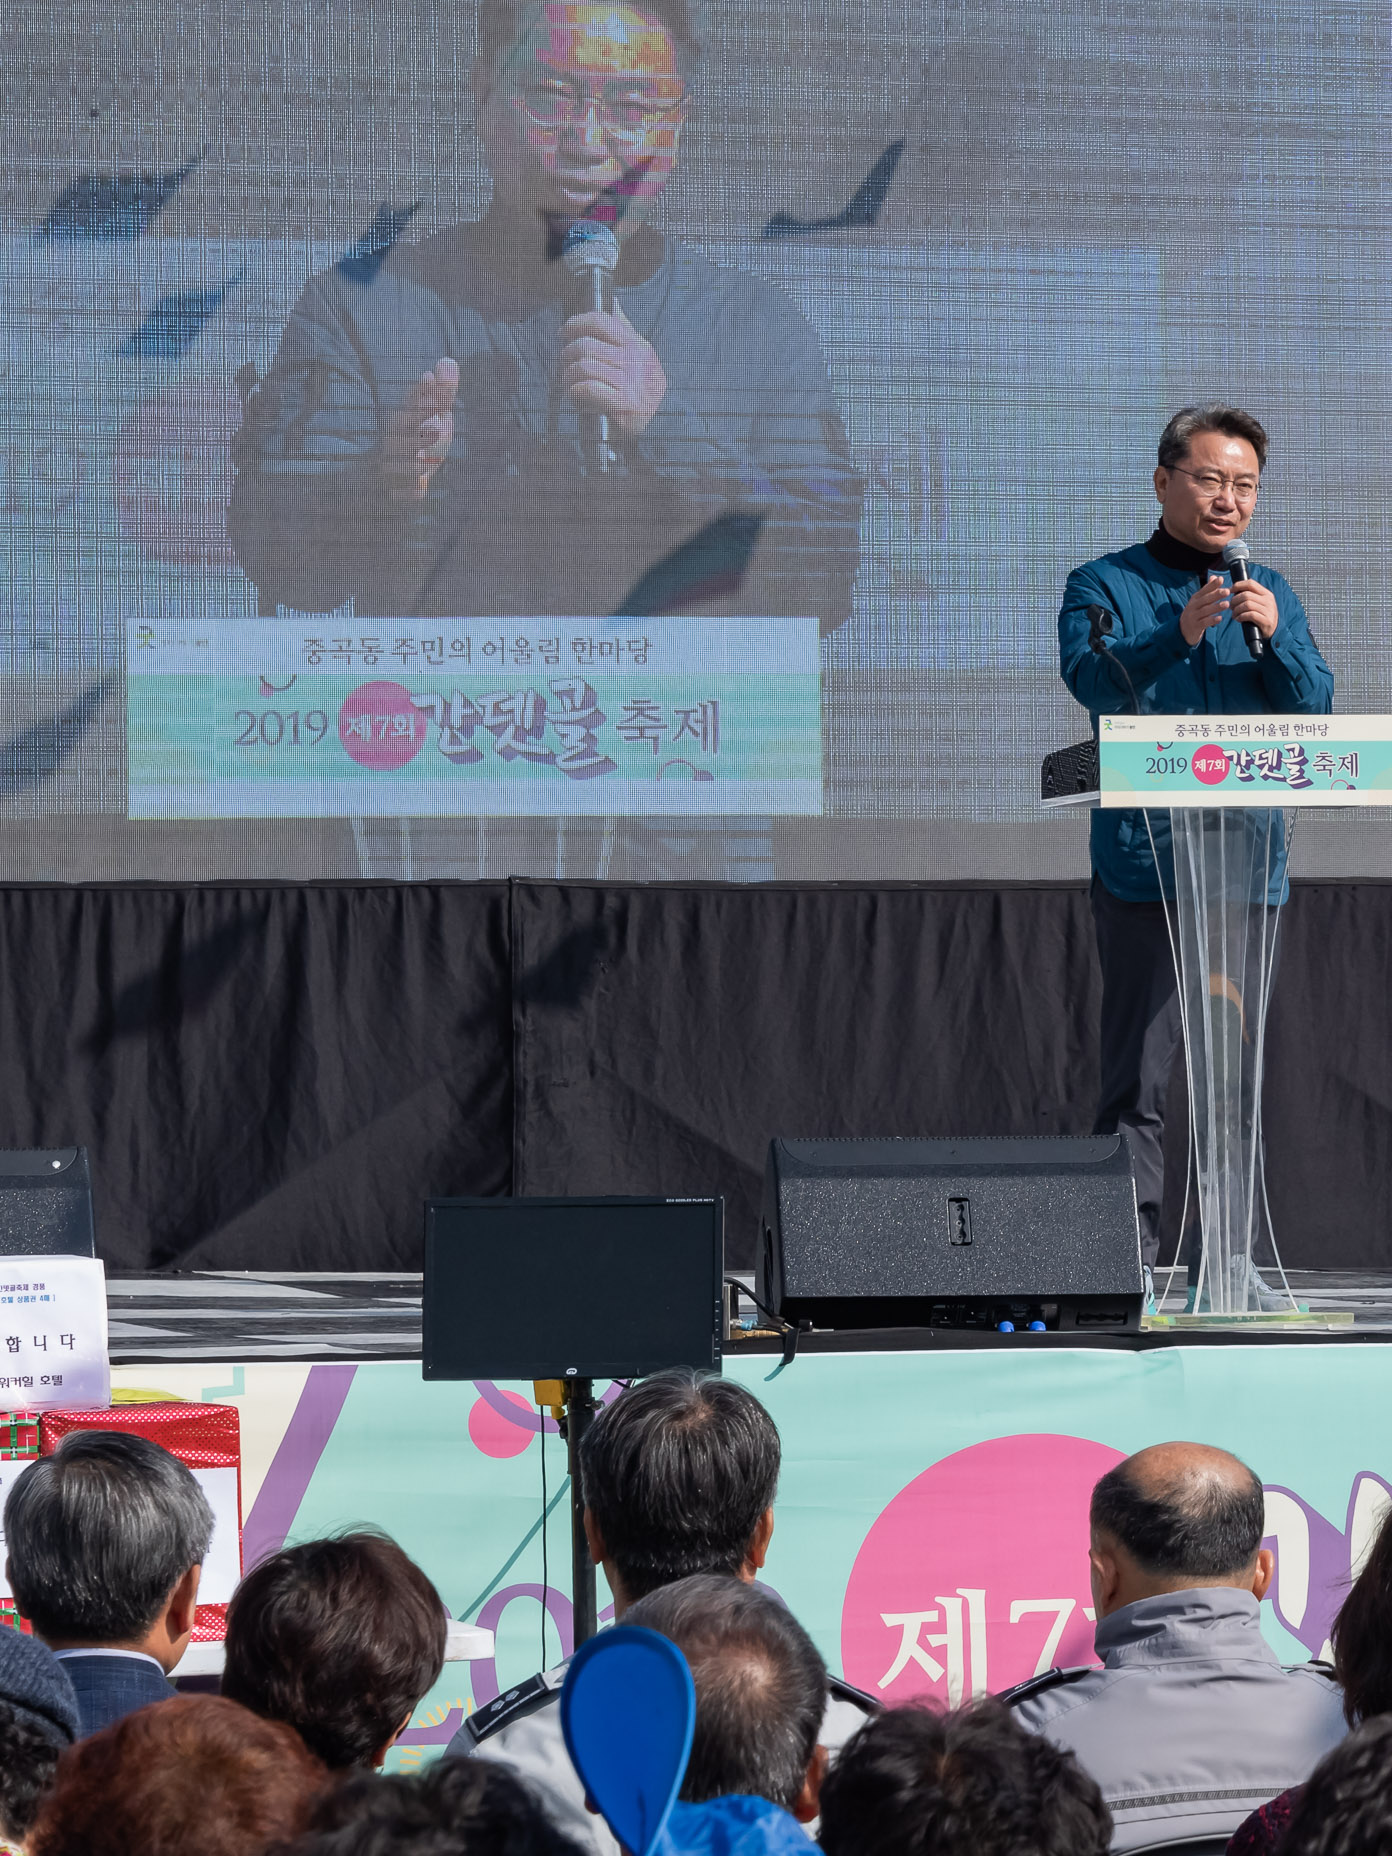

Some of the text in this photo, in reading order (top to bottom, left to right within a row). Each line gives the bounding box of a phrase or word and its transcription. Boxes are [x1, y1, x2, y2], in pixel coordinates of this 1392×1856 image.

[302, 636, 653, 665] 중곡동 주민의 어울림 한마당
[233, 709, 329, 746] 2019
[615, 698, 720, 758] 축제
[1174, 723, 1330, 738] 중곡동 주민의 어울림 한마당
[1145, 757, 1188, 774] 2019
[1194, 758, 1226, 773] 제7회
[1312, 751, 1360, 778] 축제
[40, 1375, 63, 1387] 호텔
[877, 1587, 1098, 1712] 제7
